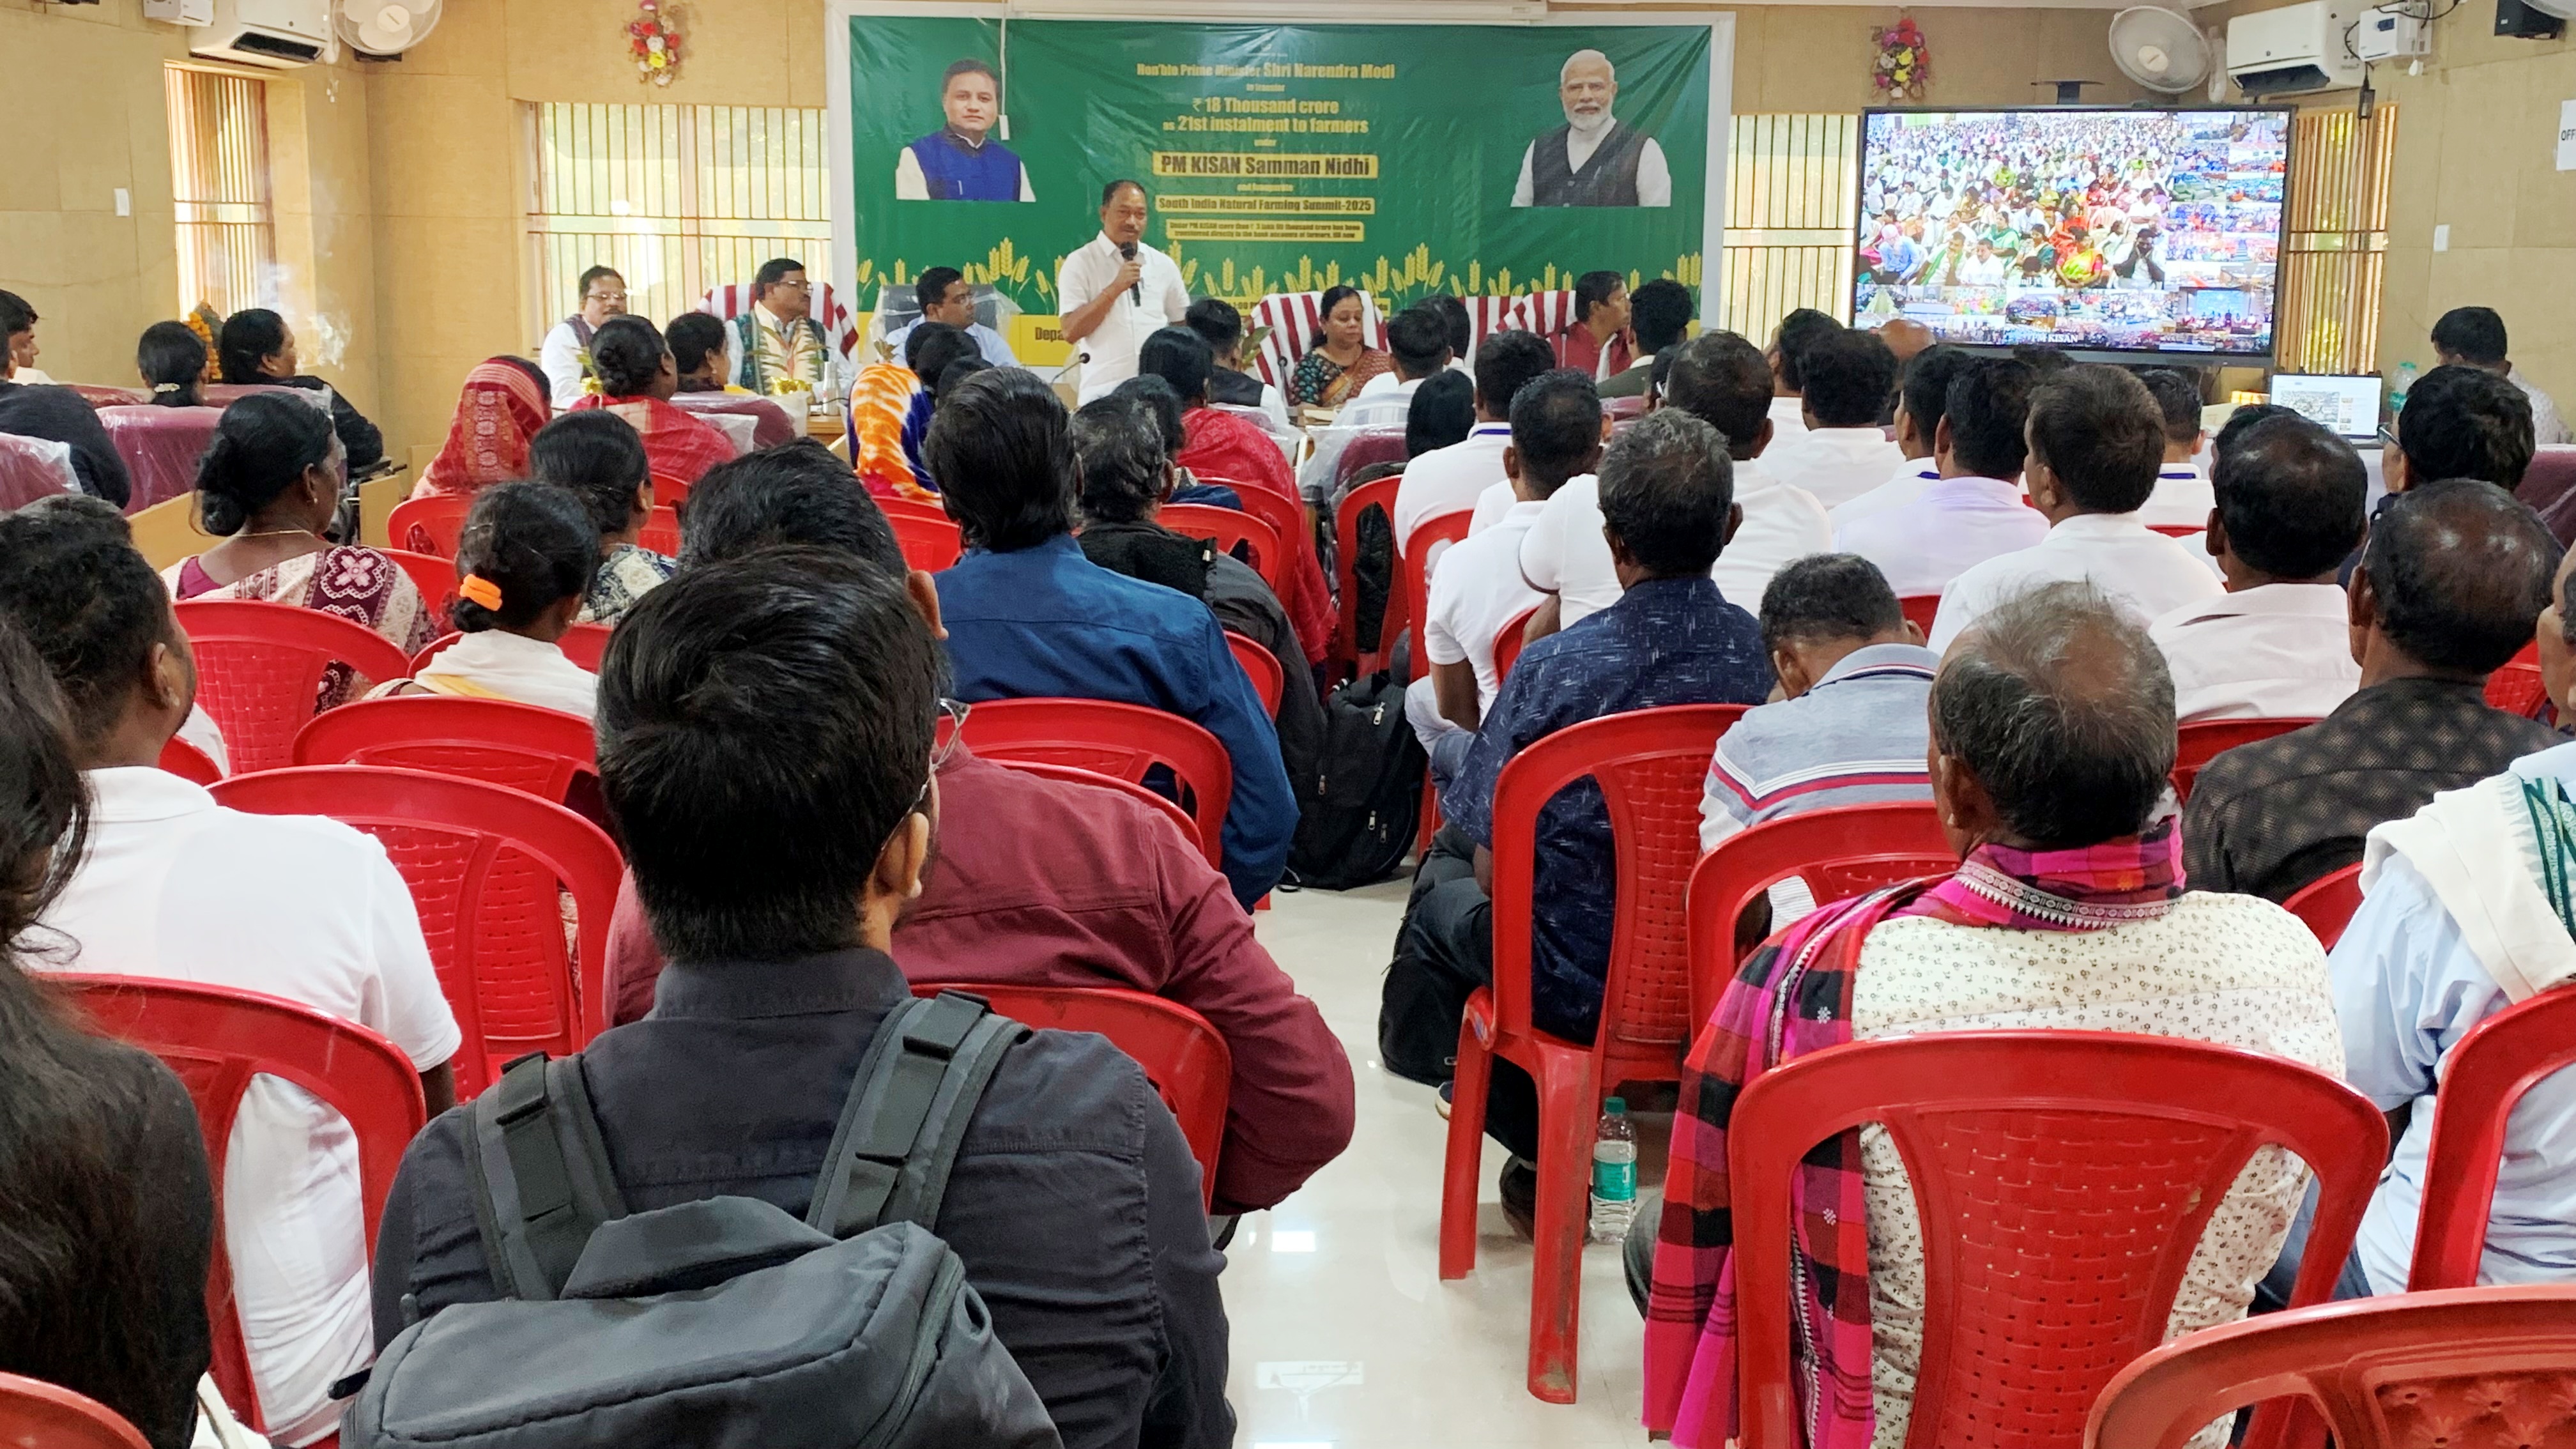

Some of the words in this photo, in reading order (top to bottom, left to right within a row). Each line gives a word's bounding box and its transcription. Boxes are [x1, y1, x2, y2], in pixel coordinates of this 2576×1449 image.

[1181, 64, 1213, 76] Prime
[1215, 65, 1260, 77] Minister
[1264, 62, 1291, 77] Shri
[1294, 63, 1358, 78] Narendra
[1361, 64, 1395, 79] Modi
[1206, 96, 1221, 112] 18
[1223, 97, 1296, 113] Thousand
[1299, 100, 1339, 114] crore
[1177, 116, 1208, 131] 21st
[1210, 116, 1290, 132] instalment
[1292, 118, 1307, 132] to
[1310, 118, 1369, 133] farmers
[1162, 155, 1186, 172] PM
[1192, 156, 1240, 174] KISAN
[1246, 157, 1320, 174] Samman
[1325, 158, 1369, 175] Nidhi
[1159, 198, 1188, 208] South
[1192, 199, 1216, 209] India
[1220, 199, 1256, 210] Natural
[1259, 199, 1300, 211] Farming
[1303, 200, 1371, 211] Summit-2025
[2048, 333, 2078, 342] KISAN
